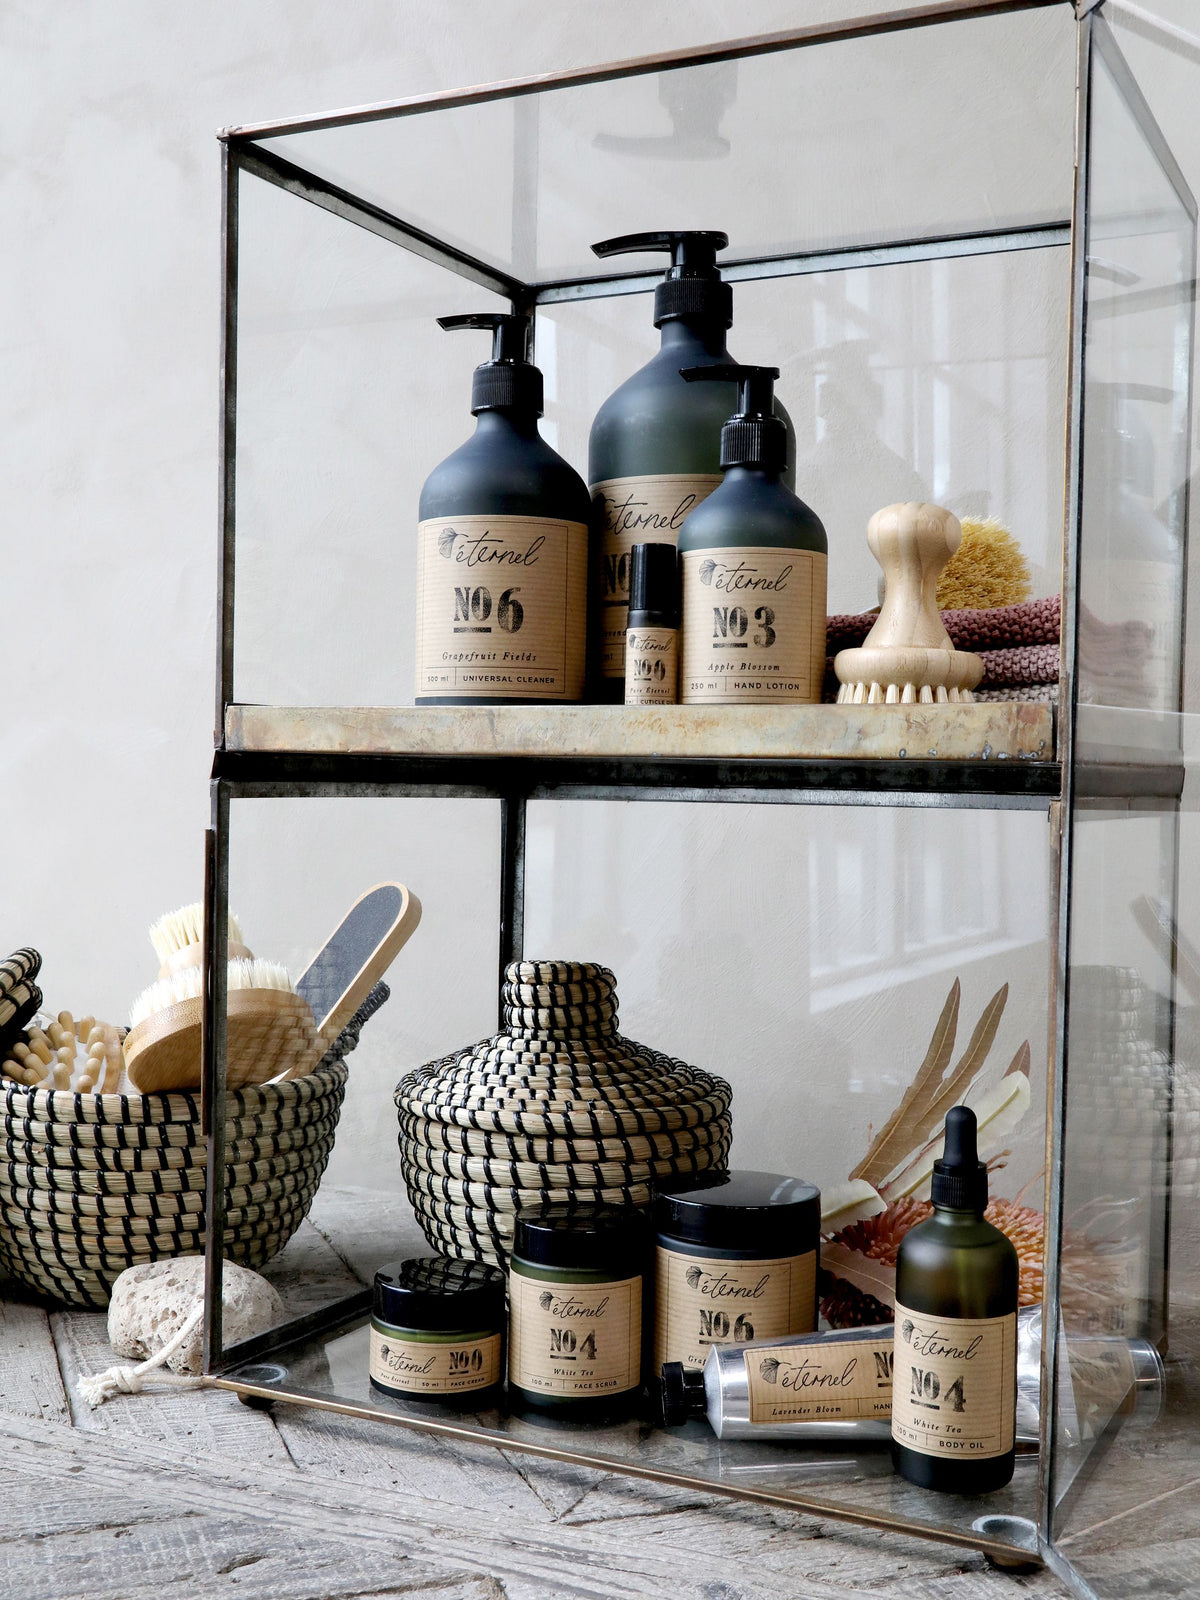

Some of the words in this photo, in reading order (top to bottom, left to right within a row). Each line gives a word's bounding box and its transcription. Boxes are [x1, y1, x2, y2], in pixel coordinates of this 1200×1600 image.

[606, 493, 696, 535] éternel
[455, 530, 546, 567] éternel
[715, 561, 793, 593] éternel
[442, 651, 497, 662] Grapefruit
[502, 651, 537, 662] Fields
[707, 662, 735, 672] Apple
[740, 662, 780, 671] Blossom
[463, 675, 513, 683] UNIVERSAL
[516, 676, 555, 684] CLEANER
[691, 682, 704, 690] 250
[734, 682, 762, 690] HAND
[766, 682, 800, 690] LOTION
[701, 1272, 770, 1299] éternel
[552, 1296, 610, 1319] éternel
[913, 1330, 984, 1361] éternel
[388, 1352, 437, 1375] éternel
[553, 1368, 577, 1376] White
[781, 1357, 858, 1392] éternel
[595, 1380, 618, 1389] SCRUB
[772, 1407, 811, 1416] Lavender
[815, 1406, 842, 1414] Bloom
[913, 1417, 940, 1431] White
[945, 1425, 962, 1433] Tea
[908, 1433, 918, 1441] ml
[939, 1440, 965, 1449] BODY
[969, 1441, 984, 1449] OIL
